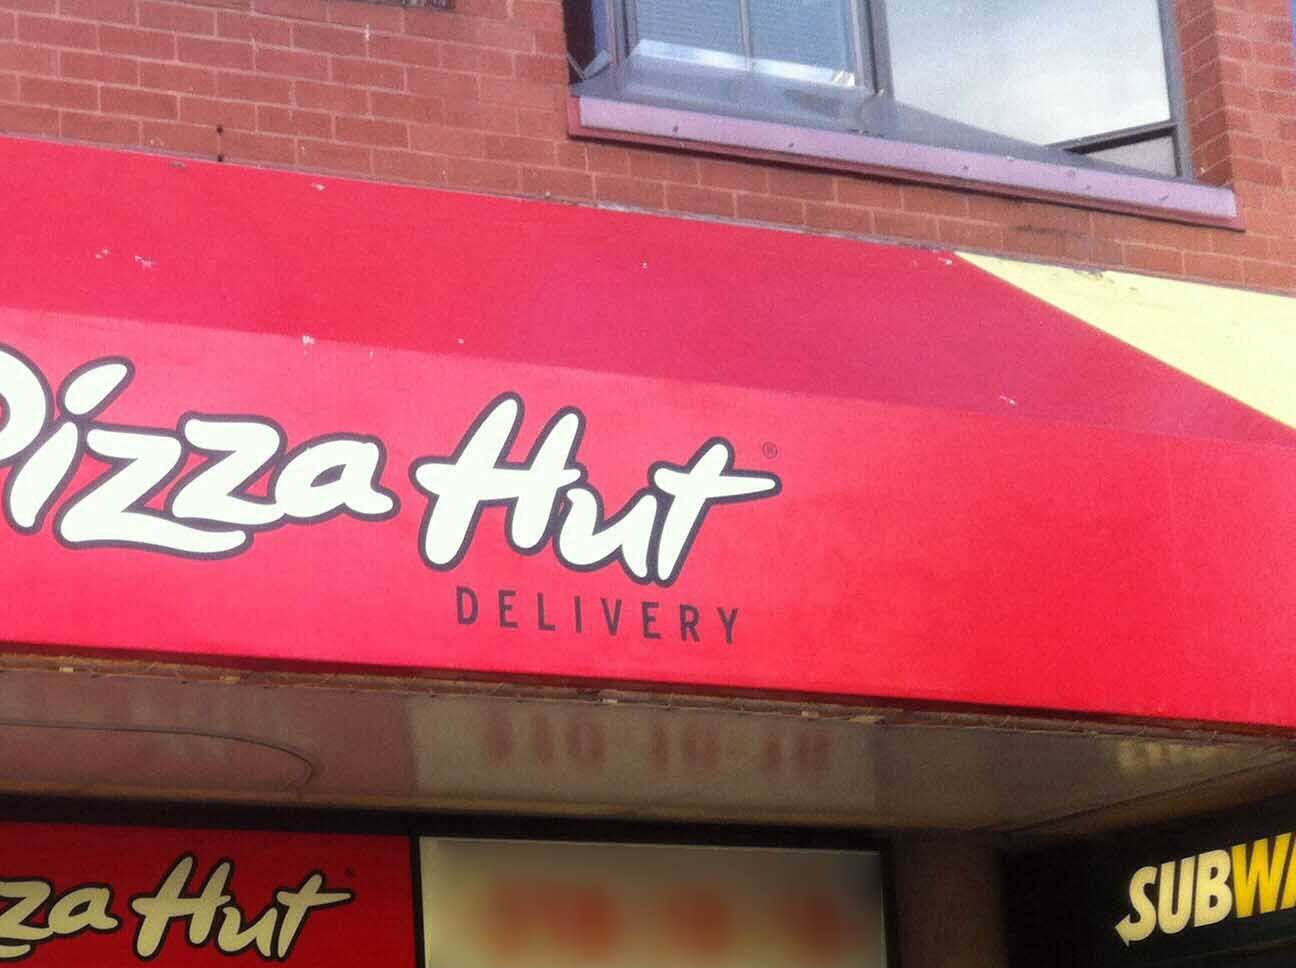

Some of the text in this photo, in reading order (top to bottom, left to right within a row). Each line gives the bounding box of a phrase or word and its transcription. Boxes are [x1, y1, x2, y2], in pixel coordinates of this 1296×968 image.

[410, 392, 782, 587] Hut
[457, 585, 740, 645] DELIVERY
[130, 852, 355, 962] Hut
